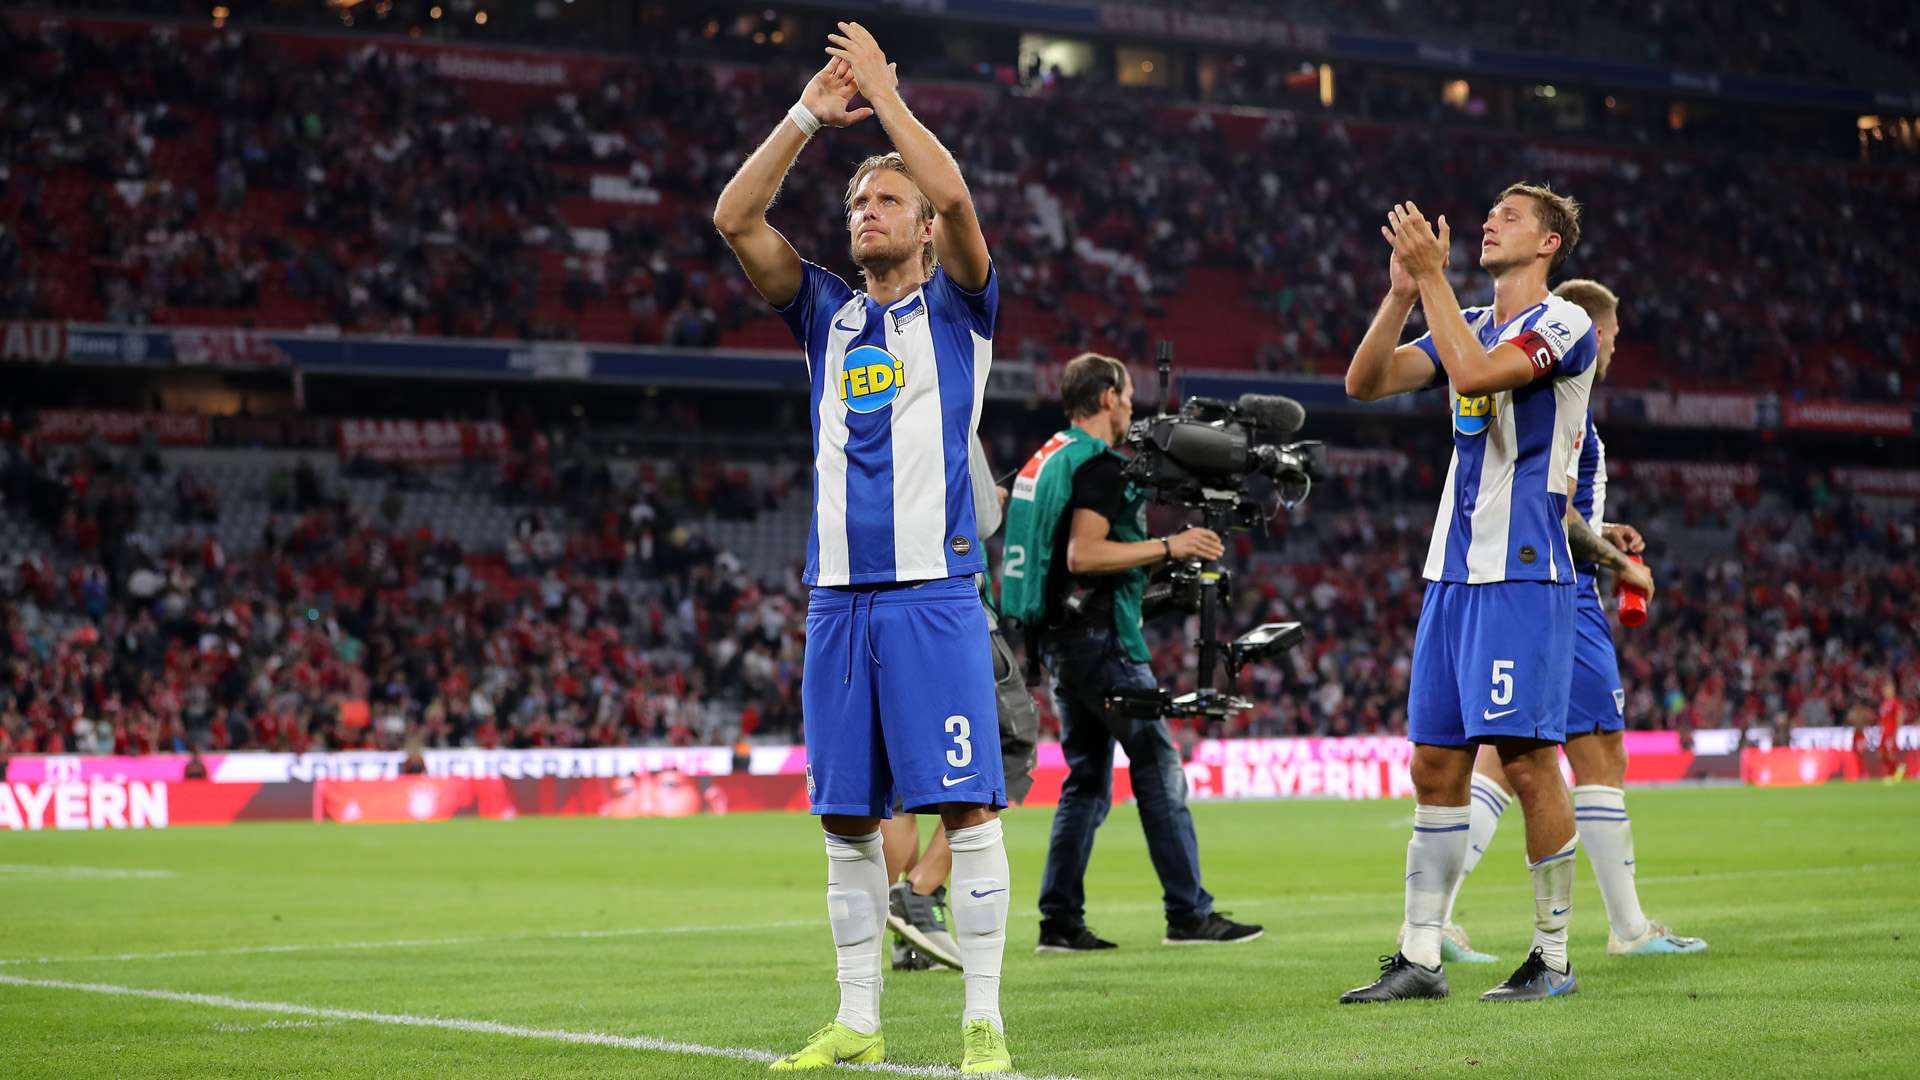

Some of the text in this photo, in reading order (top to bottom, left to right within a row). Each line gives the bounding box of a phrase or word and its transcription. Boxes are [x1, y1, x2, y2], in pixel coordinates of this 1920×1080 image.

[840, 360, 905, 401] TEDi
[1456, 391, 1498, 417] EDi
[1003, 544, 1026, 579] 2
[1490, 659, 1515, 706] 5
[944, 714, 973, 768] 3
[1224, 760, 1379, 799] BAYERN
[0, 781, 168, 829] AYERN
